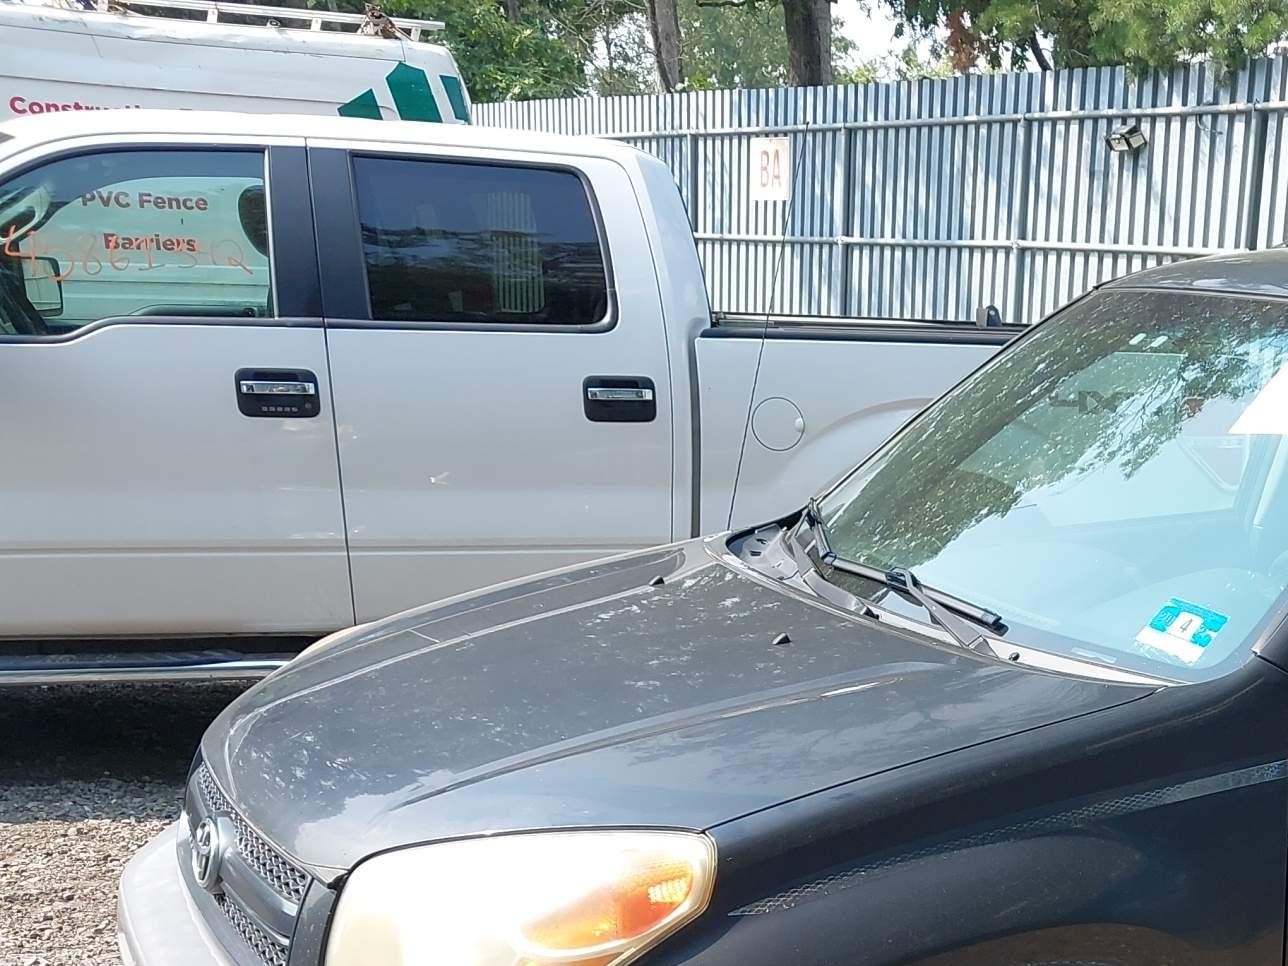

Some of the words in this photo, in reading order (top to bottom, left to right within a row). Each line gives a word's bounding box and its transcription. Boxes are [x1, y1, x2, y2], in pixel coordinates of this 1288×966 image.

[80, 190, 131, 209] PVC
[138, 191, 209, 211] Fence
[103, 232, 197, 253] Barriers
[1179, 618, 1193, 633] 4
